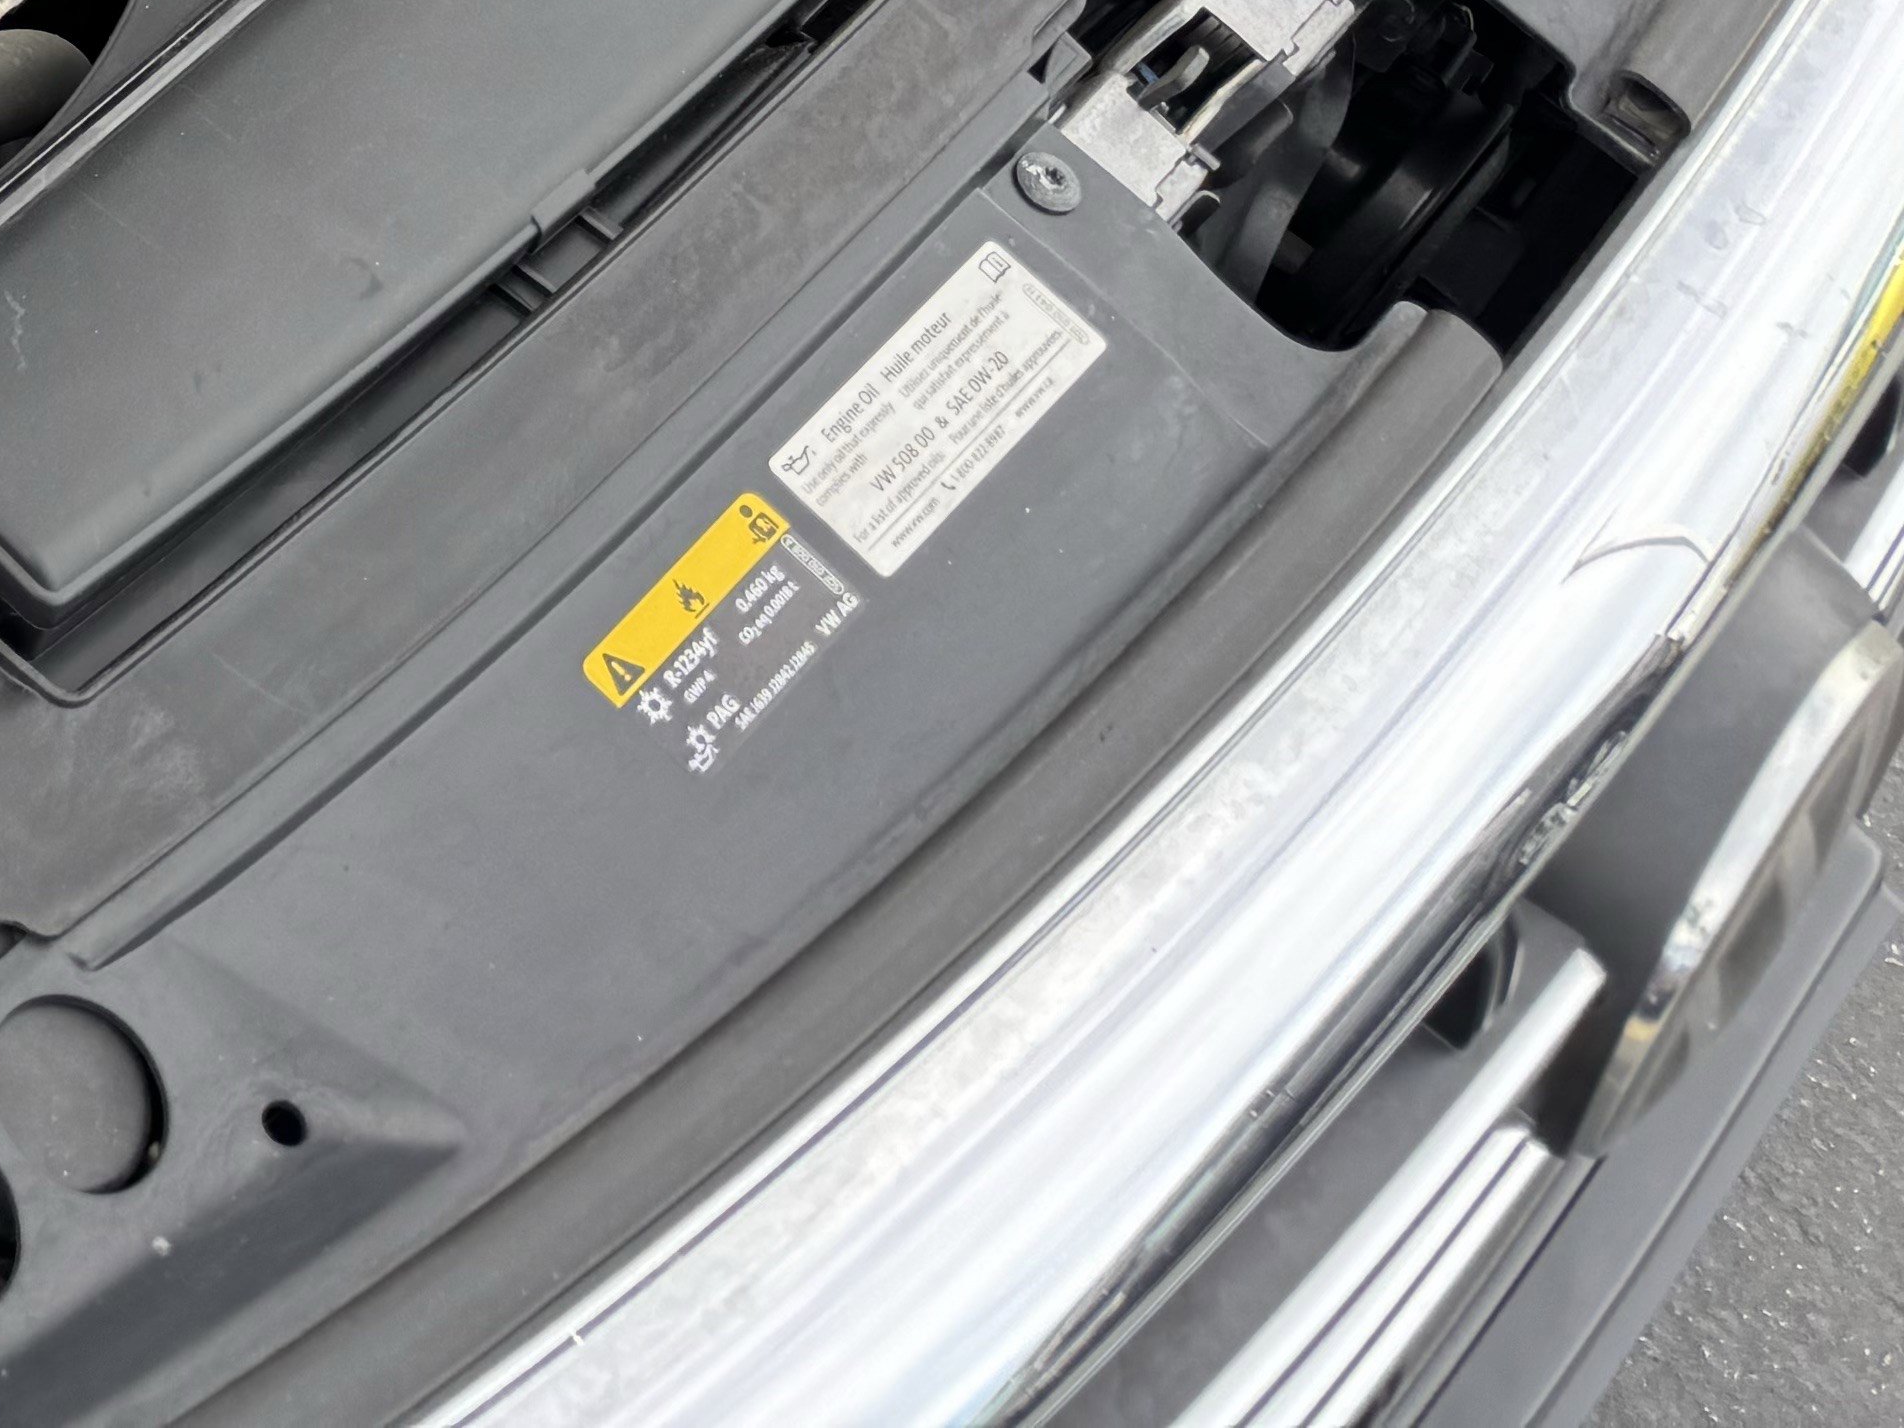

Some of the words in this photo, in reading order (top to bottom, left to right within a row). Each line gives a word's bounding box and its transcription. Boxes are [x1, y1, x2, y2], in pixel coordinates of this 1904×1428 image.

[819, 398, 868, 447] Engine
[855, 381, 881, 407] Oil
[878, 347, 916, 384] Huile
[907, 309, 954, 355] moteur
[868, 464, 899, 495] VW
[889, 441, 921, 473] 508
[911, 424, 937, 449] 00
[930, 411, 950, 430] &
[943, 386, 974, 416] SAE
[964, 348, 1011, 394] 0W-20
[731, 575, 772, 615] 0.460
[759, 560, 787, 588] kg
[812, 608, 843, 639] VW
[832, 589, 861, 617] AG
[658, 625, 725, 693] R-1234yf
[680, 675, 710, 705] GWP
[702, 690, 742, 730] PAG
